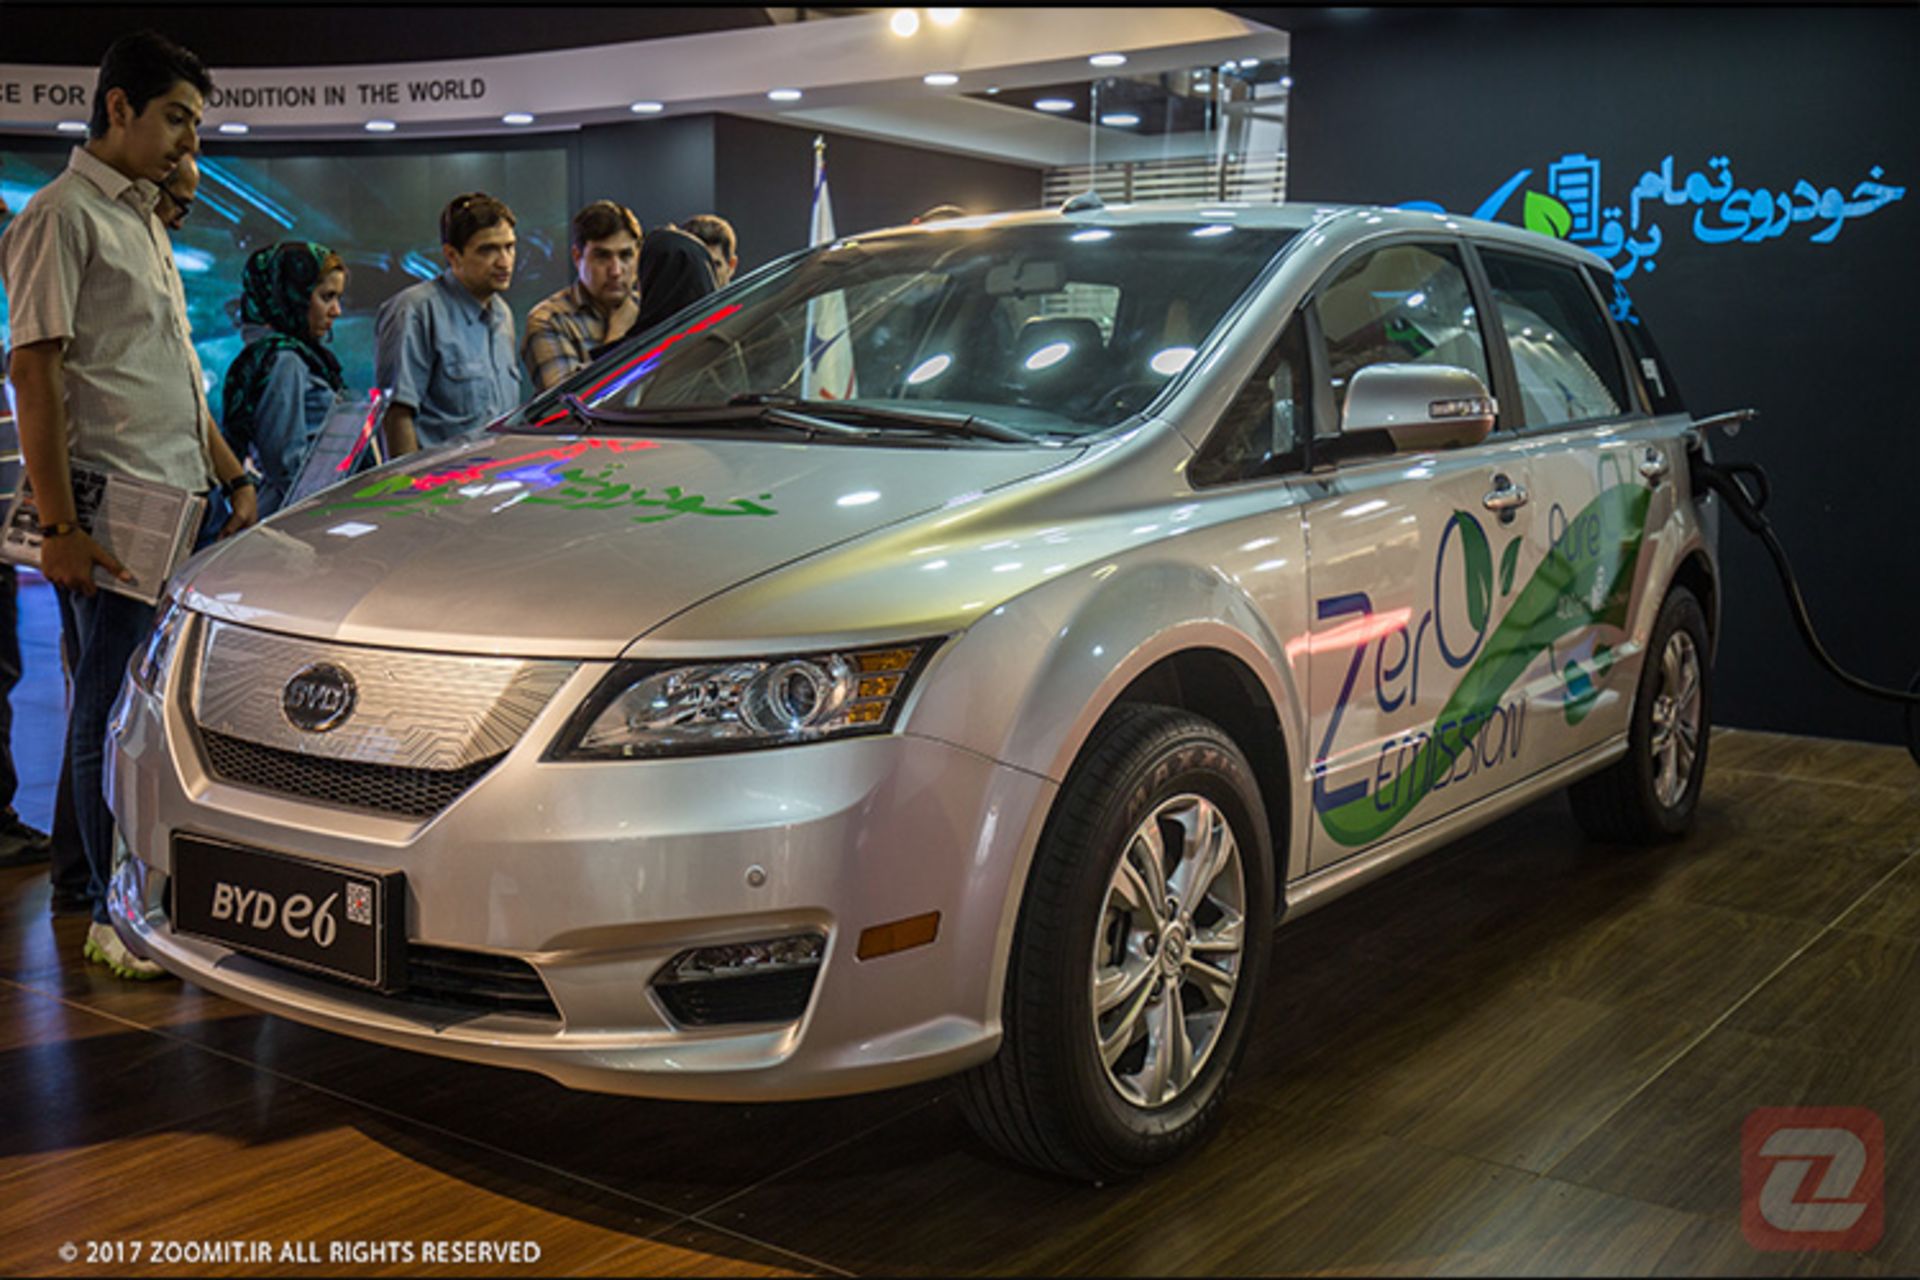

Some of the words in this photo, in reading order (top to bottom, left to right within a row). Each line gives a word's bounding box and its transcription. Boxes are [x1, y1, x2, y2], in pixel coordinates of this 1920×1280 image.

[33, 84, 86, 105] FOR
[207, 85, 316, 108] ONDITION
[324, 84, 345, 105] IN
[357, 82, 400, 104] THE
[408, 78, 486, 103] WORLD
[1629, 154, 1734, 231] تمام
[1693, 165, 1906, 243] خودروی
[211, 882, 276, 930] BYD
[281, 892, 339, 947] e6
